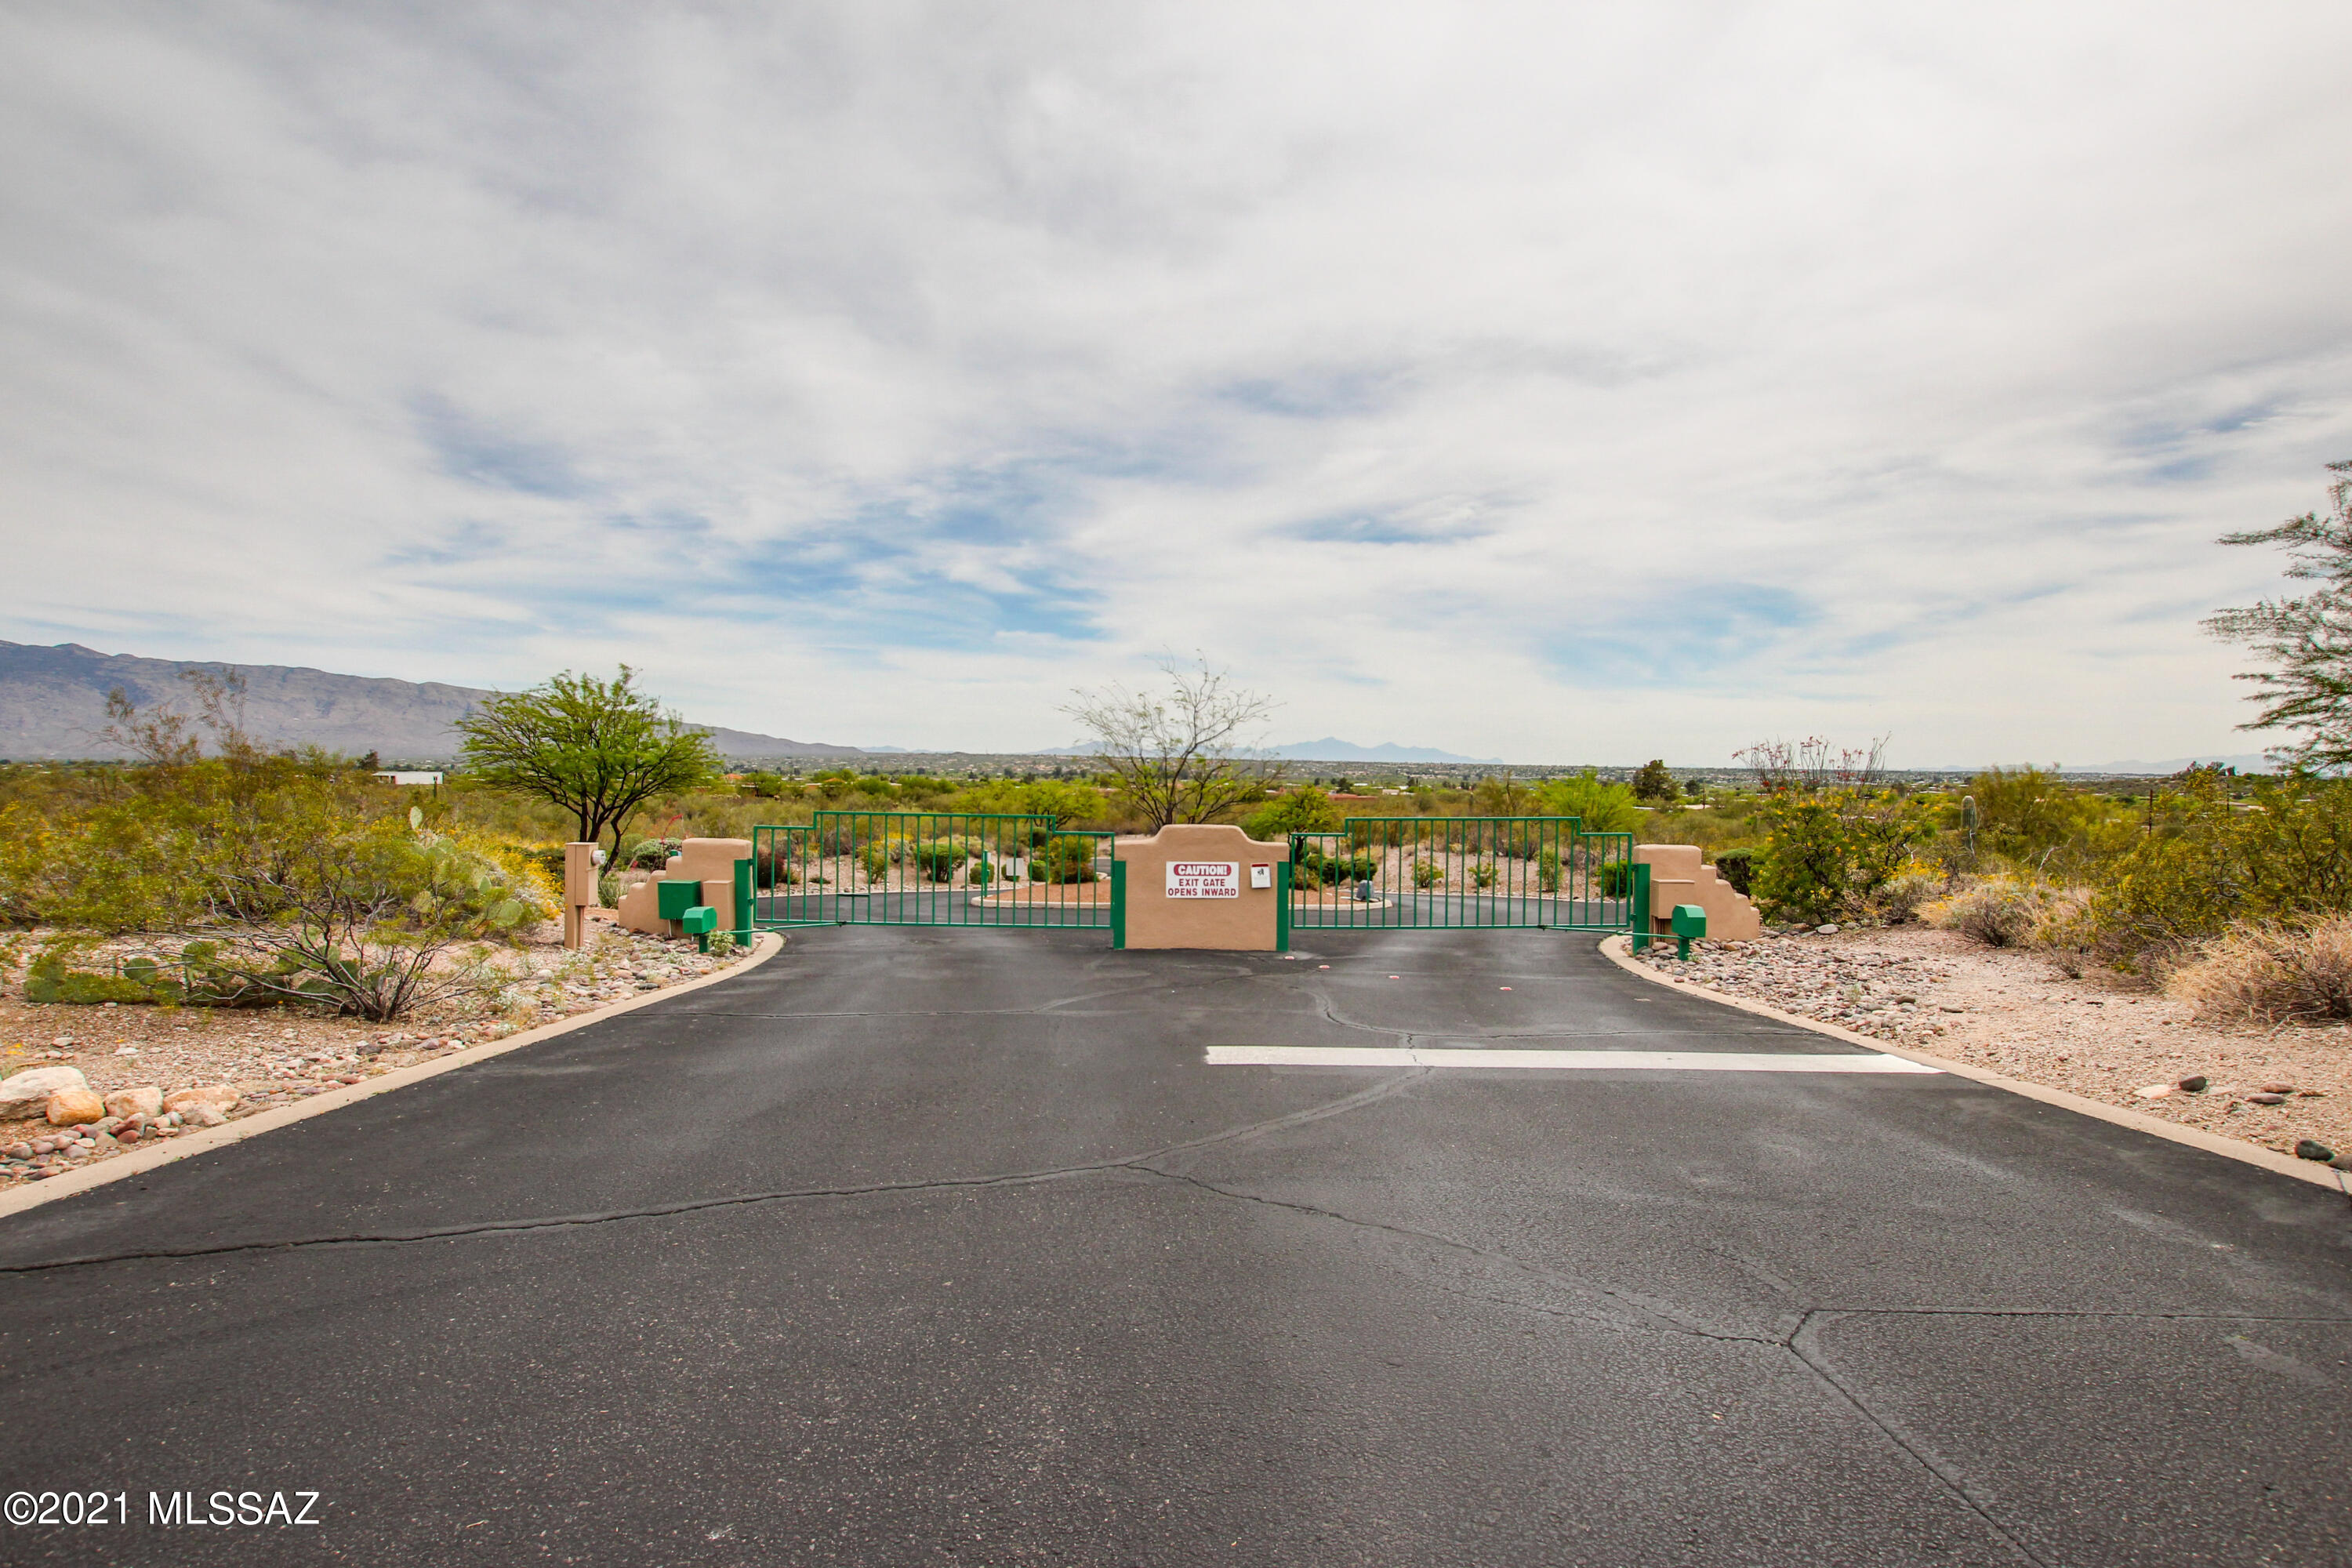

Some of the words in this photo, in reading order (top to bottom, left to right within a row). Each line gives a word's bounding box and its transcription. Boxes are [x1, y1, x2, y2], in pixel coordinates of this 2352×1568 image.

[1178, 865, 1228, 875] CAUTION!
[1178, 878, 1200, 887] EXIT
[1203, 878, 1225, 887] GATE
[1167, 887, 1198, 896] OPENS
[1201, 887, 1236, 896] INWARD
